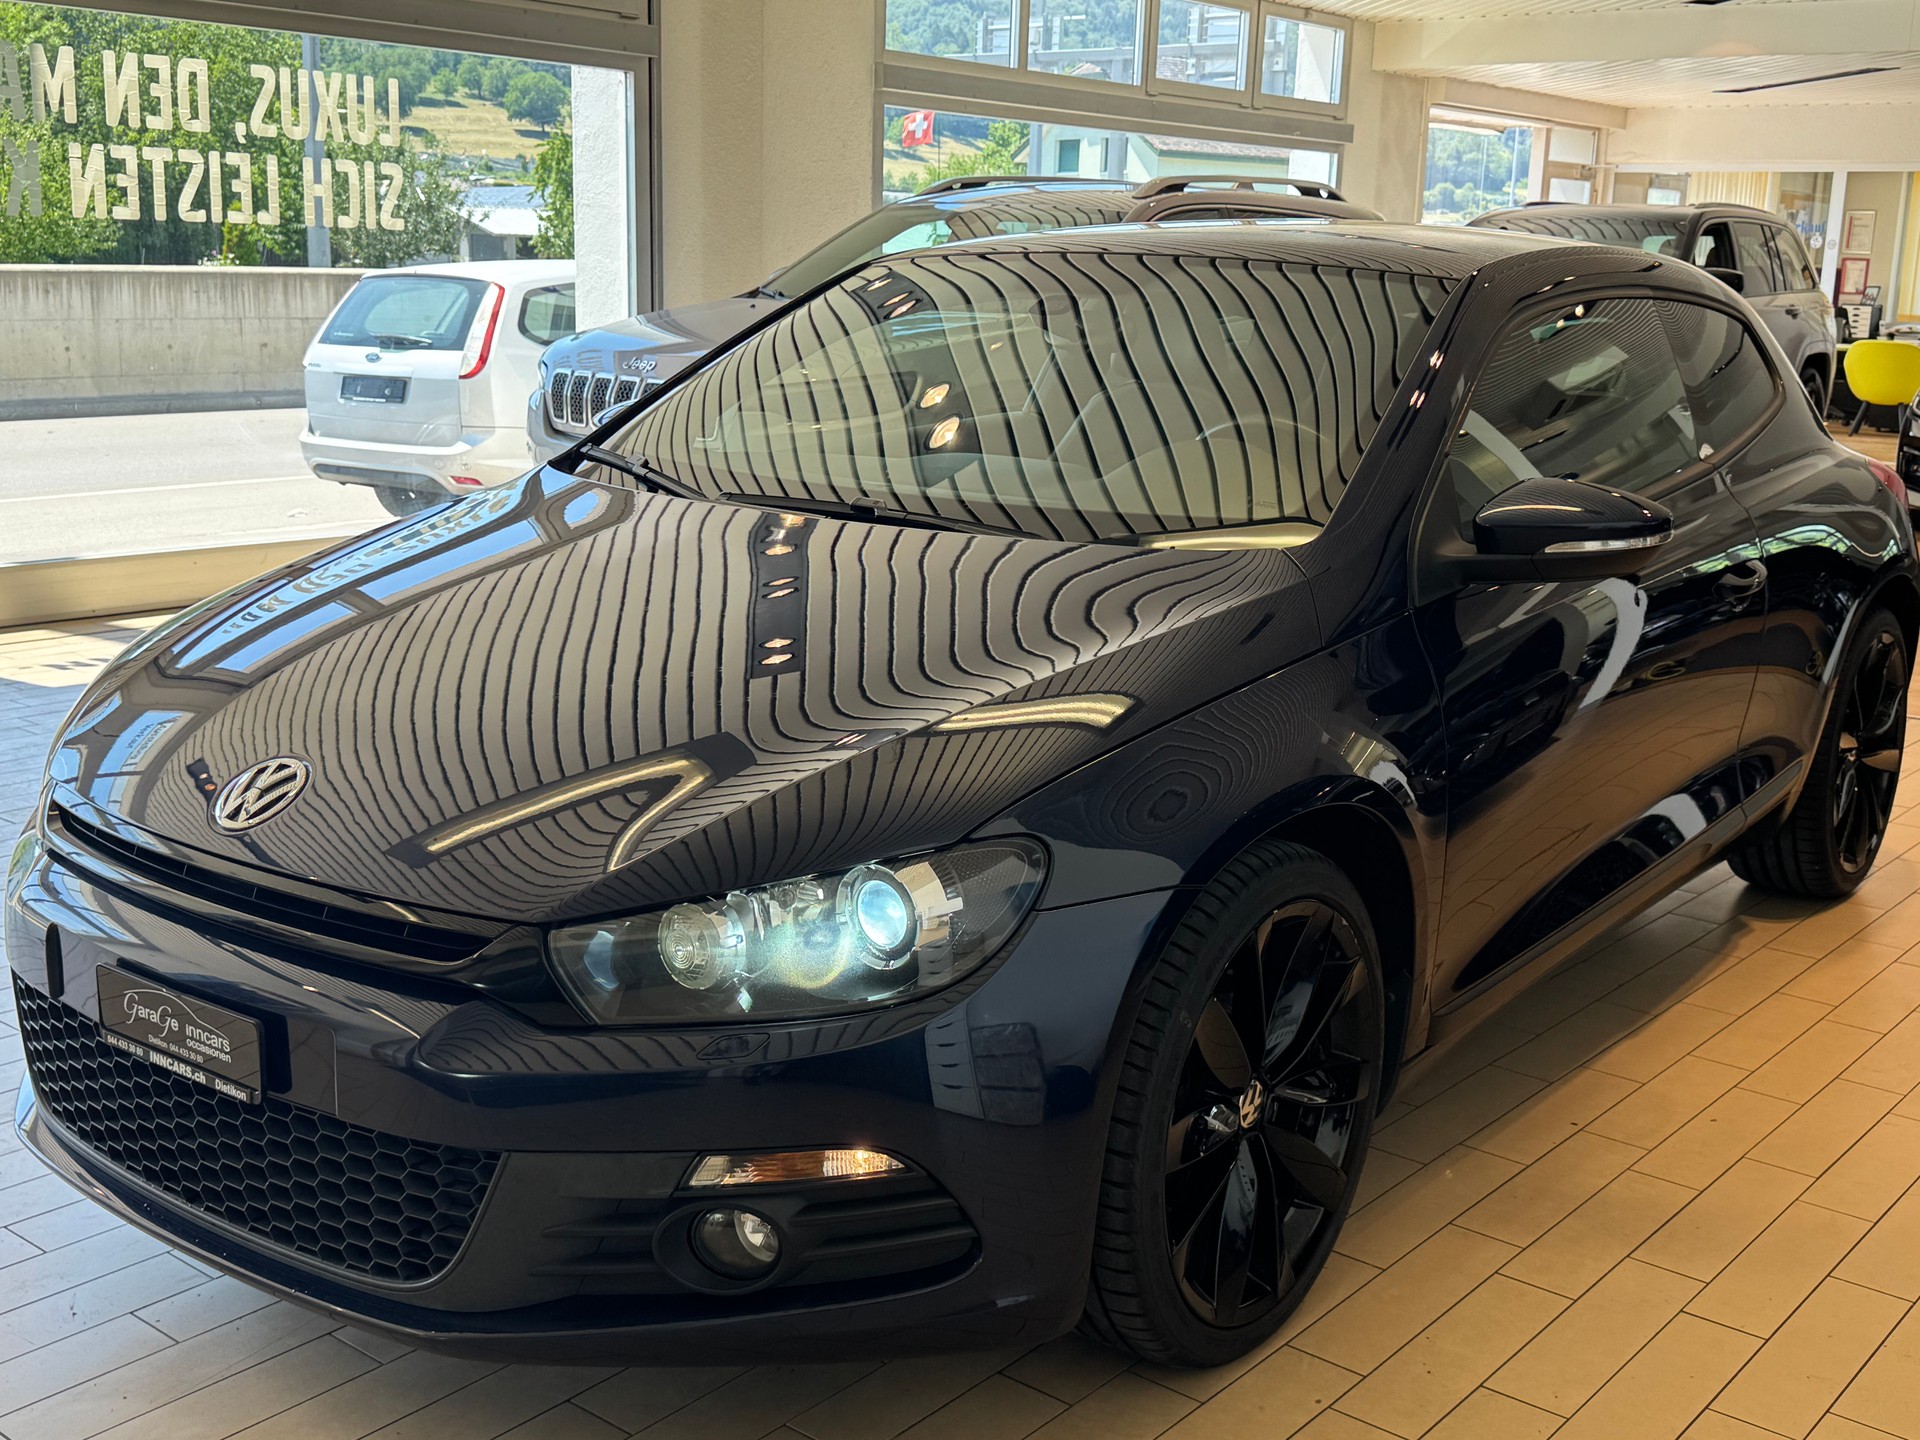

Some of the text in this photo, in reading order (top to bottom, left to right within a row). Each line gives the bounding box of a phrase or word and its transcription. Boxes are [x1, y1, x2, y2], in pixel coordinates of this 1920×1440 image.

[622, 357, 657, 373] Jeep
[185, 1023, 231, 1053] inncars
[186, 1038, 232, 1064] occasionen
[149, 1050, 206, 1085] INNCARS.ch
[215, 1078, 247, 1101] Dietikon
